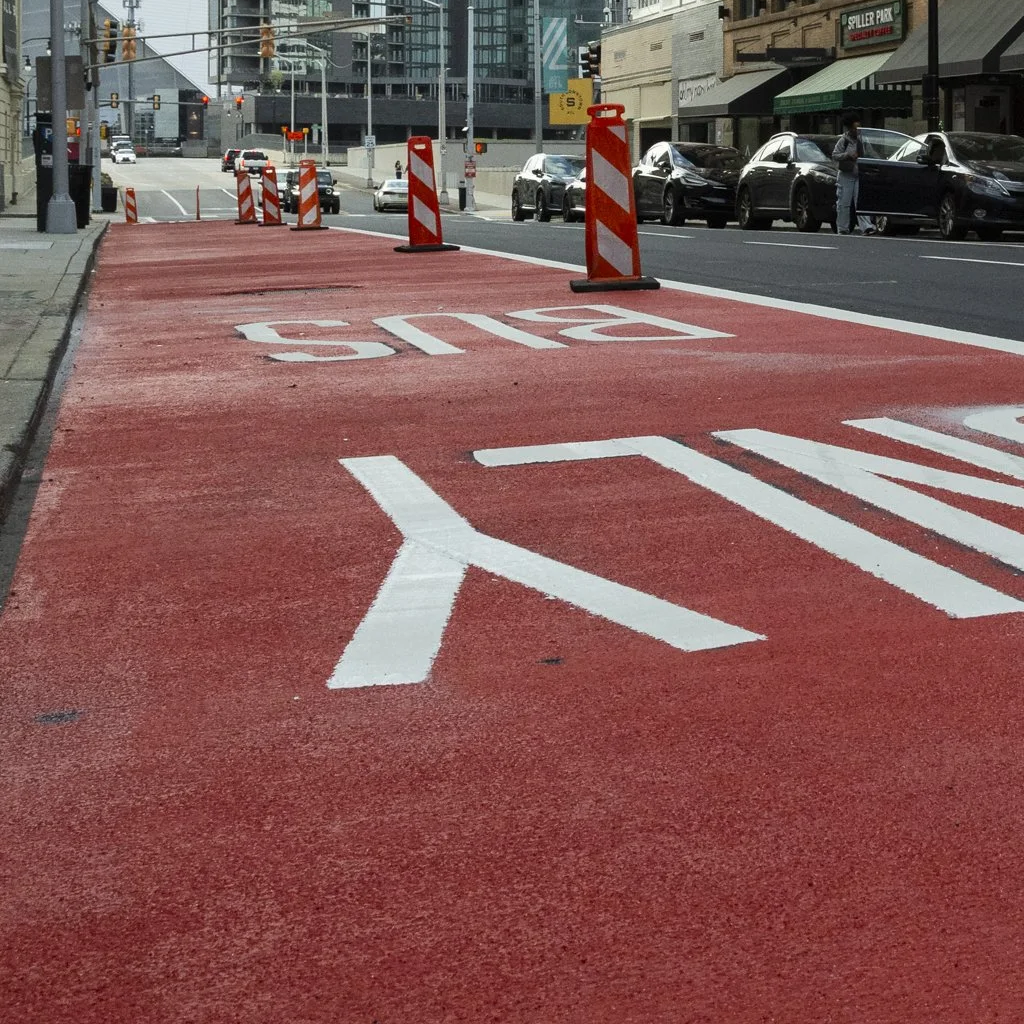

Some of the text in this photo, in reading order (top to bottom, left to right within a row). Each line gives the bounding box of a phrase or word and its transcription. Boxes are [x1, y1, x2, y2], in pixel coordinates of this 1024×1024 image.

[847, 7, 894, 30] SPILLER PARK
[566, 97, 576, 107] S
[235, 304, 736, 362] BUS
